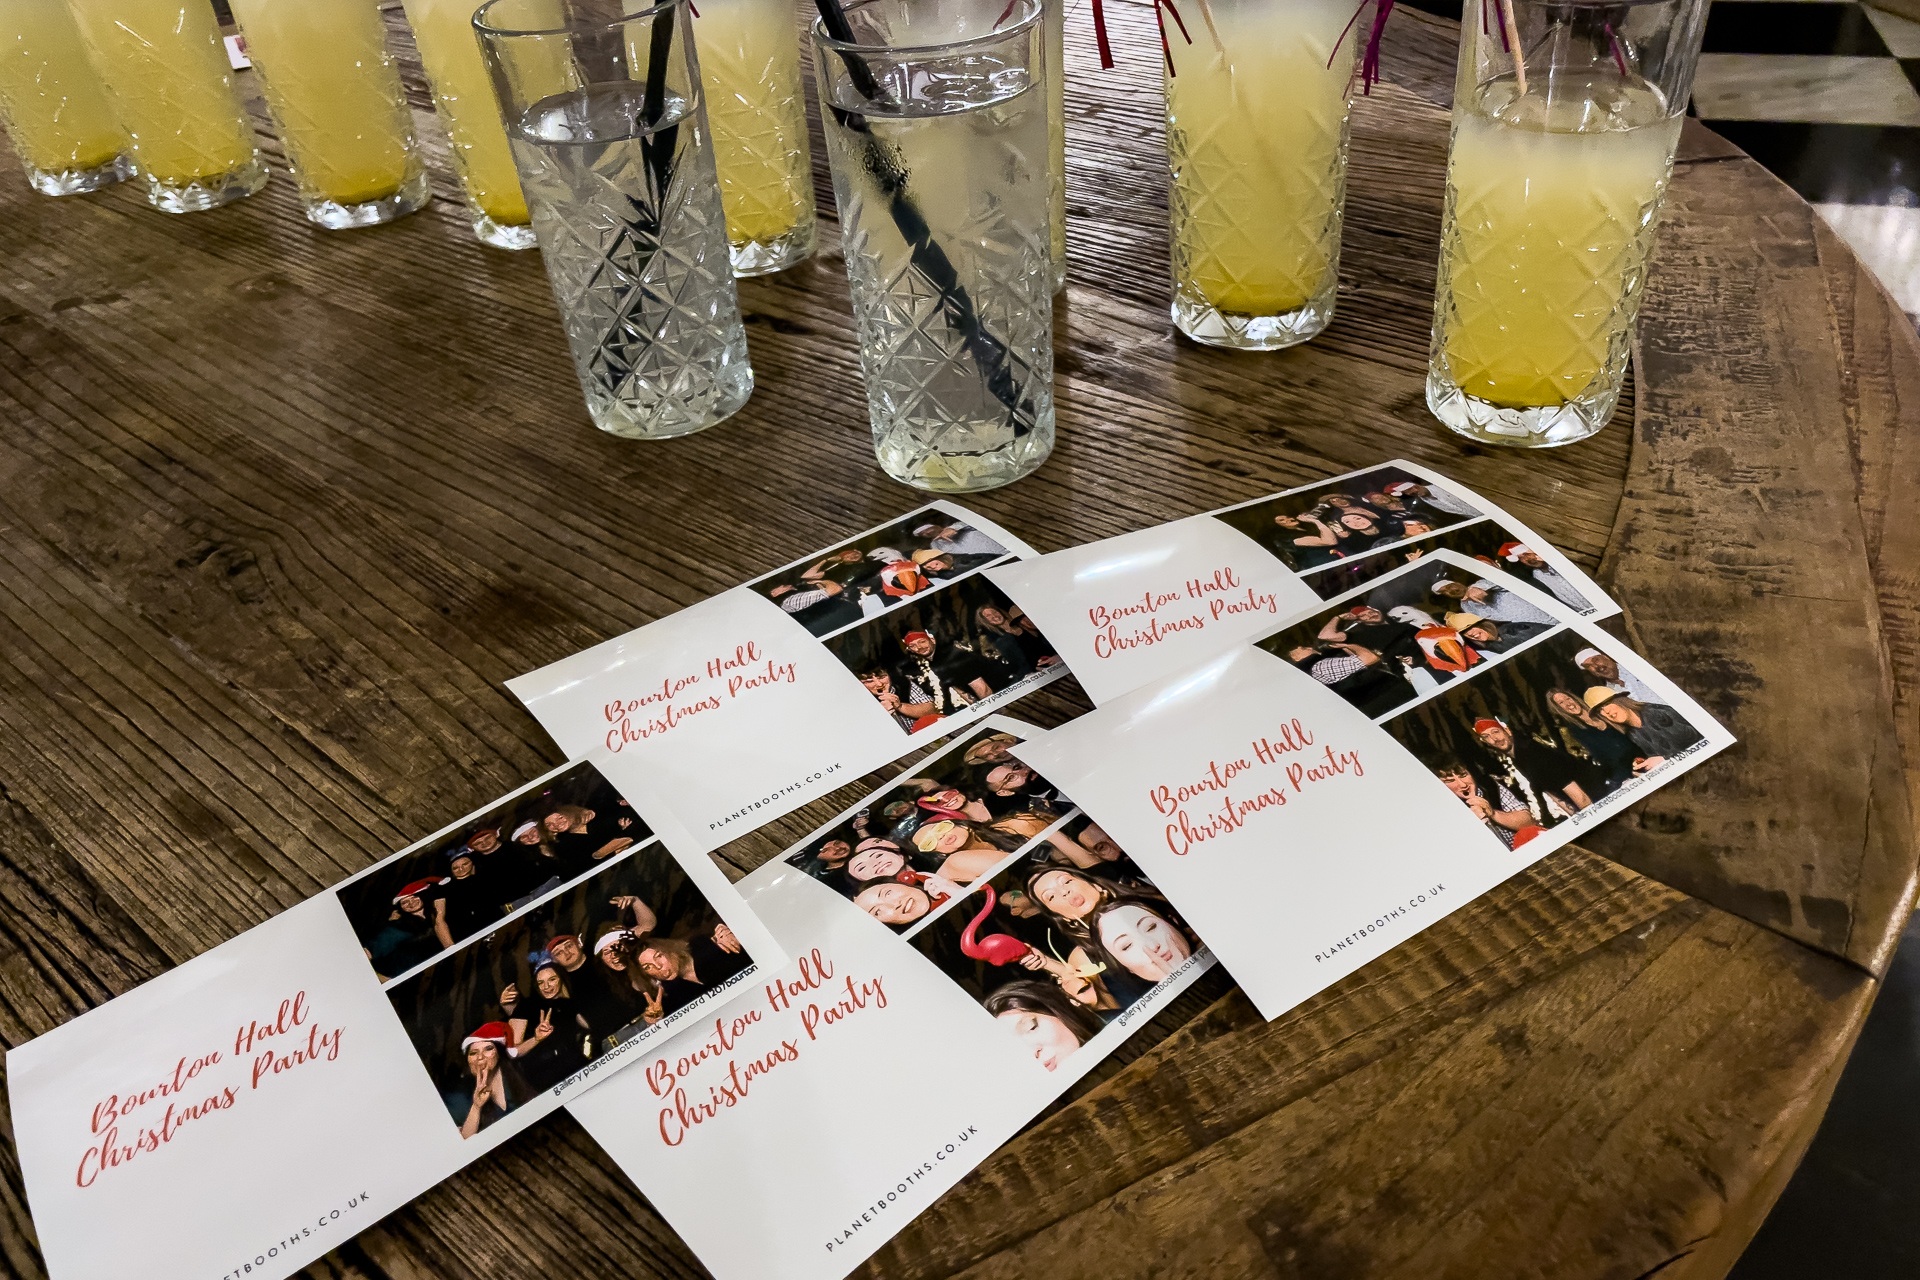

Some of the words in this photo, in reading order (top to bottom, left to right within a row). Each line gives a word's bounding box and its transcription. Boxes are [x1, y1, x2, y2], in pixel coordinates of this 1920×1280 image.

[1089, 591, 1181, 630] Bourton
[1186, 566, 1240, 599] Hall
[1094, 615, 1205, 659] Christmas
[1209, 588, 1277, 621] Party
[604, 675, 700, 725] Bourton
[707, 641, 762, 679] Hall
[606, 695, 722, 753] Christmas
[728, 660, 796, 698] Party
[709, 762, 842, 831] PLANETBOOTHS.CO.UK
[1150, 760, 1251, 817] Bourton
[1252, 718, 1314, 765] Hall
[1165, 786, 1287, 856] Christmas
[1285, 745, 1364, 792] Party
[1645, 759, 1675, 782] password
[1314, 882, 1447, 963] PLANETBOOTHS.CO.UK
[645, 1009, 762, 1101] Bourton
[765, 948, 834, 1012] Hall
[663, 996, 706, 1028] password
[76, 1085, 240, 1188] Christmas
[251, 1023, 347, 1090] Party
[91, 1049, 224, 1138] Bourton
[234, 990, 310, 1056] Hall
[658, 1038, 800, 1147] Christmas
[800, 974, 888, 1041] Party
[825, 1124, 978, 1252] PLANETBOOTHS.CO.UK
